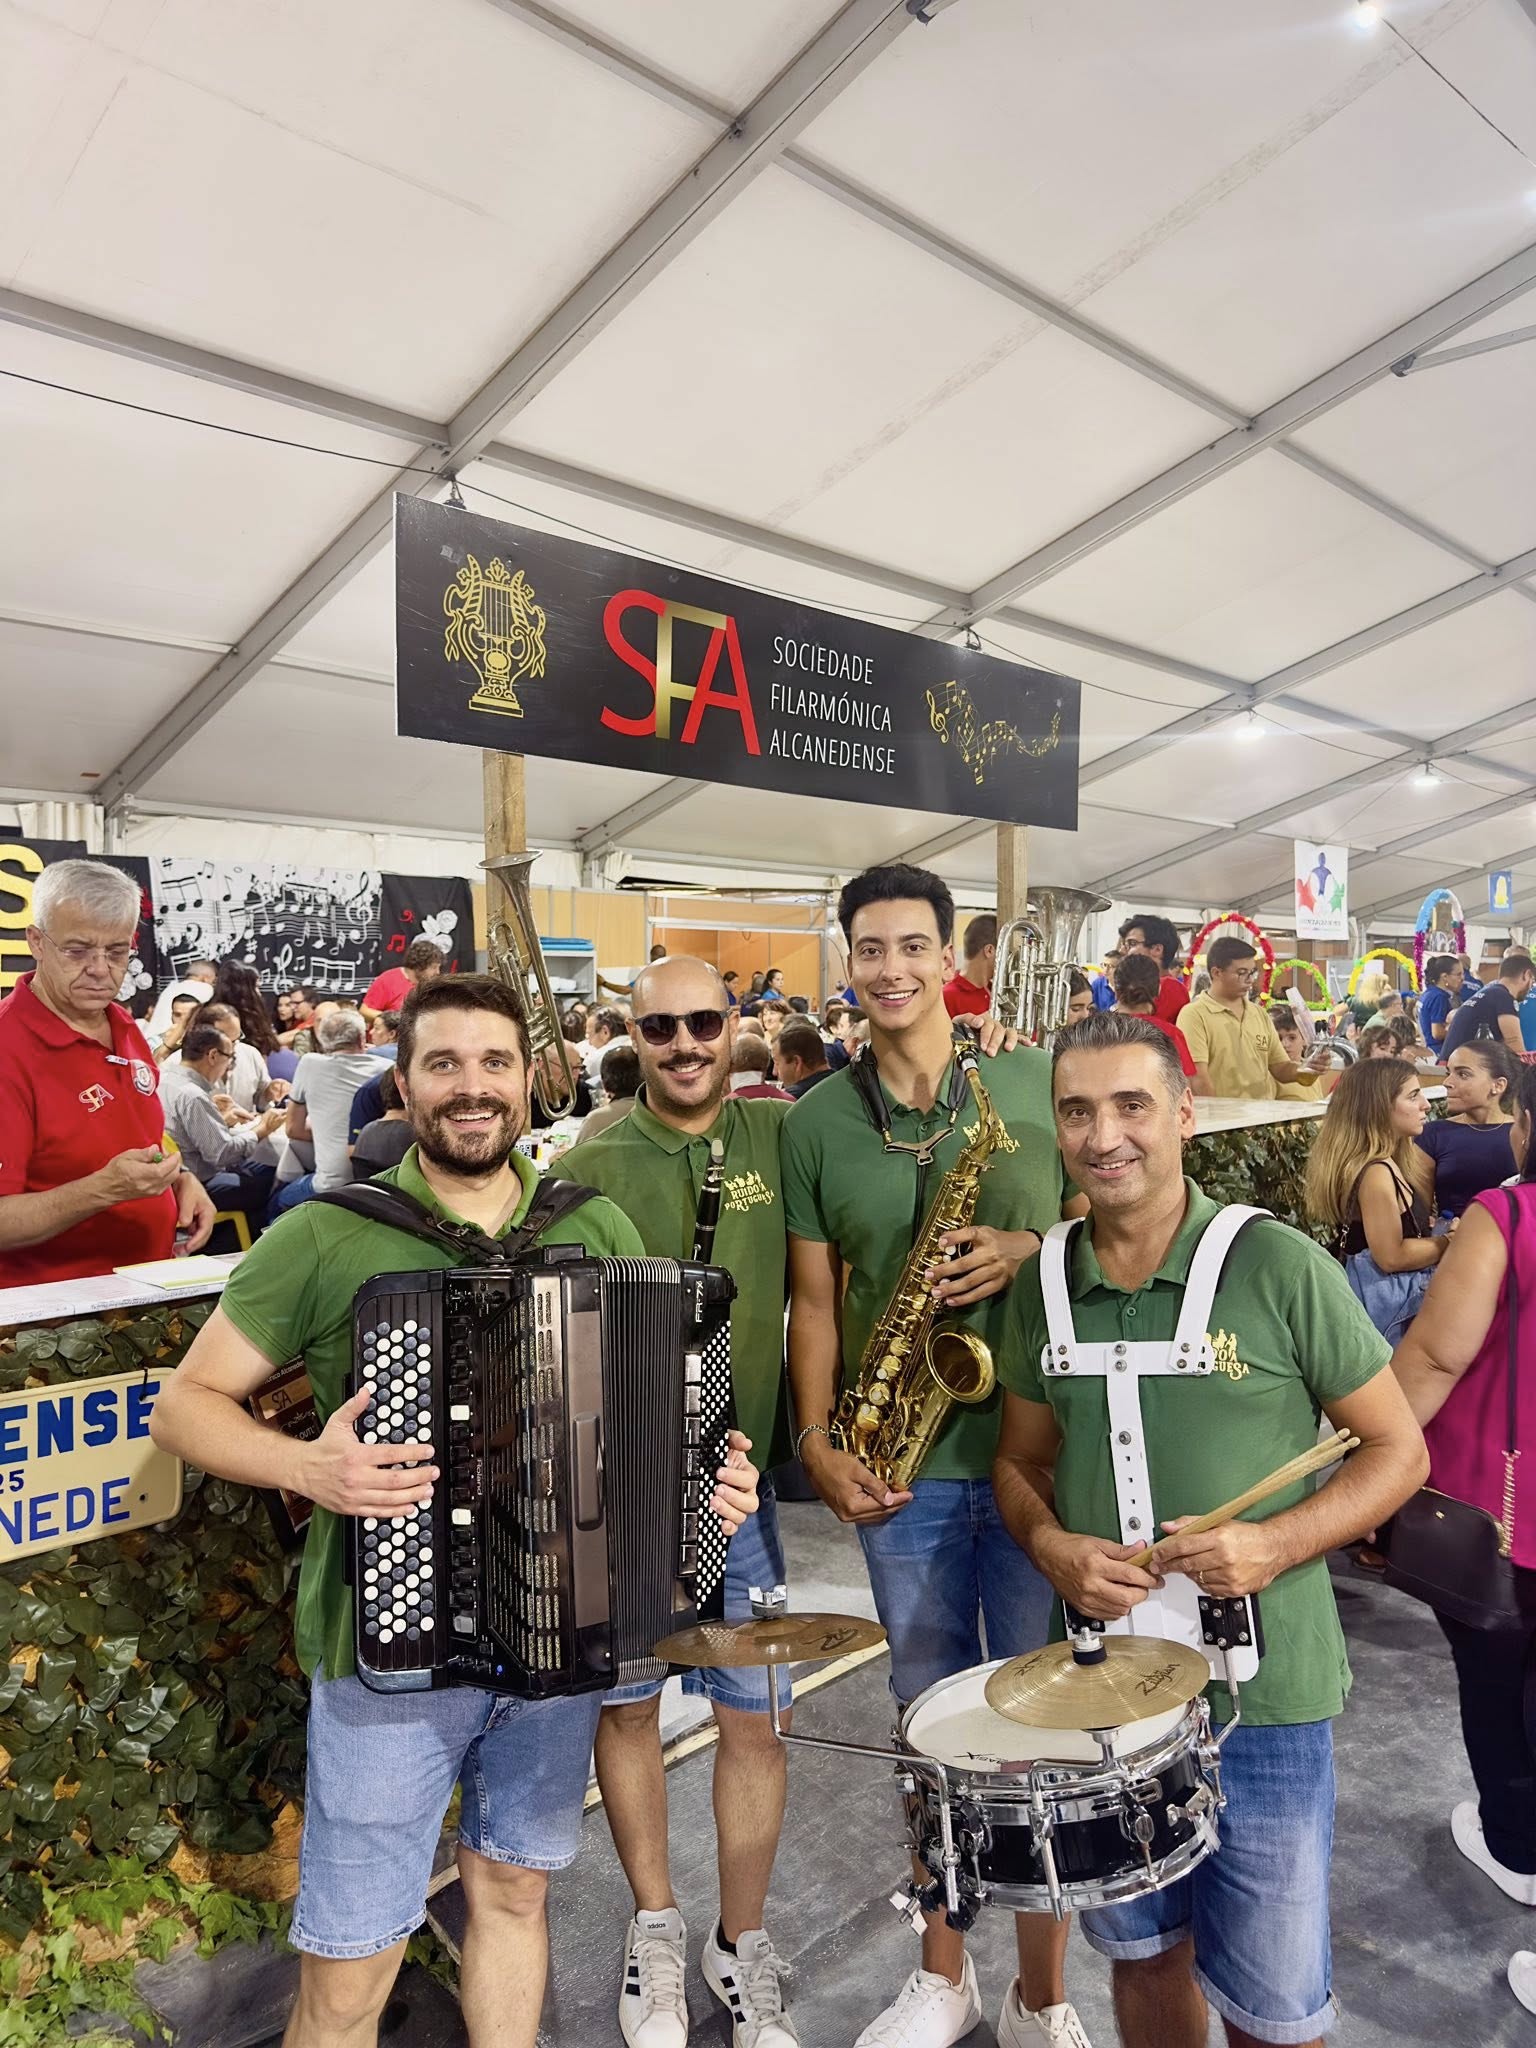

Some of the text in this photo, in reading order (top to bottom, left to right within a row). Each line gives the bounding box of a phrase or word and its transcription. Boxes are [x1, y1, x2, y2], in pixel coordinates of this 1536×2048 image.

[600, 589, 761, 756] SFA
[773, 636, 874, 685] SOCIEDADE
[771, 683, 892, 732] FILARMÓNICA
[769, 728, 896, 774] ALCANEDENSE
[724, 1189, 775, 1212] PORTUGUESA
[730, 1184, 760, 1200] RUIDO
[1212, 1361, 1250, 1381] GUESA
[0, 1381, 161, 1465] ENSE
[0, 1477, 130, 1545] NEDE
[646, 1921, 666, 1930] adidas
